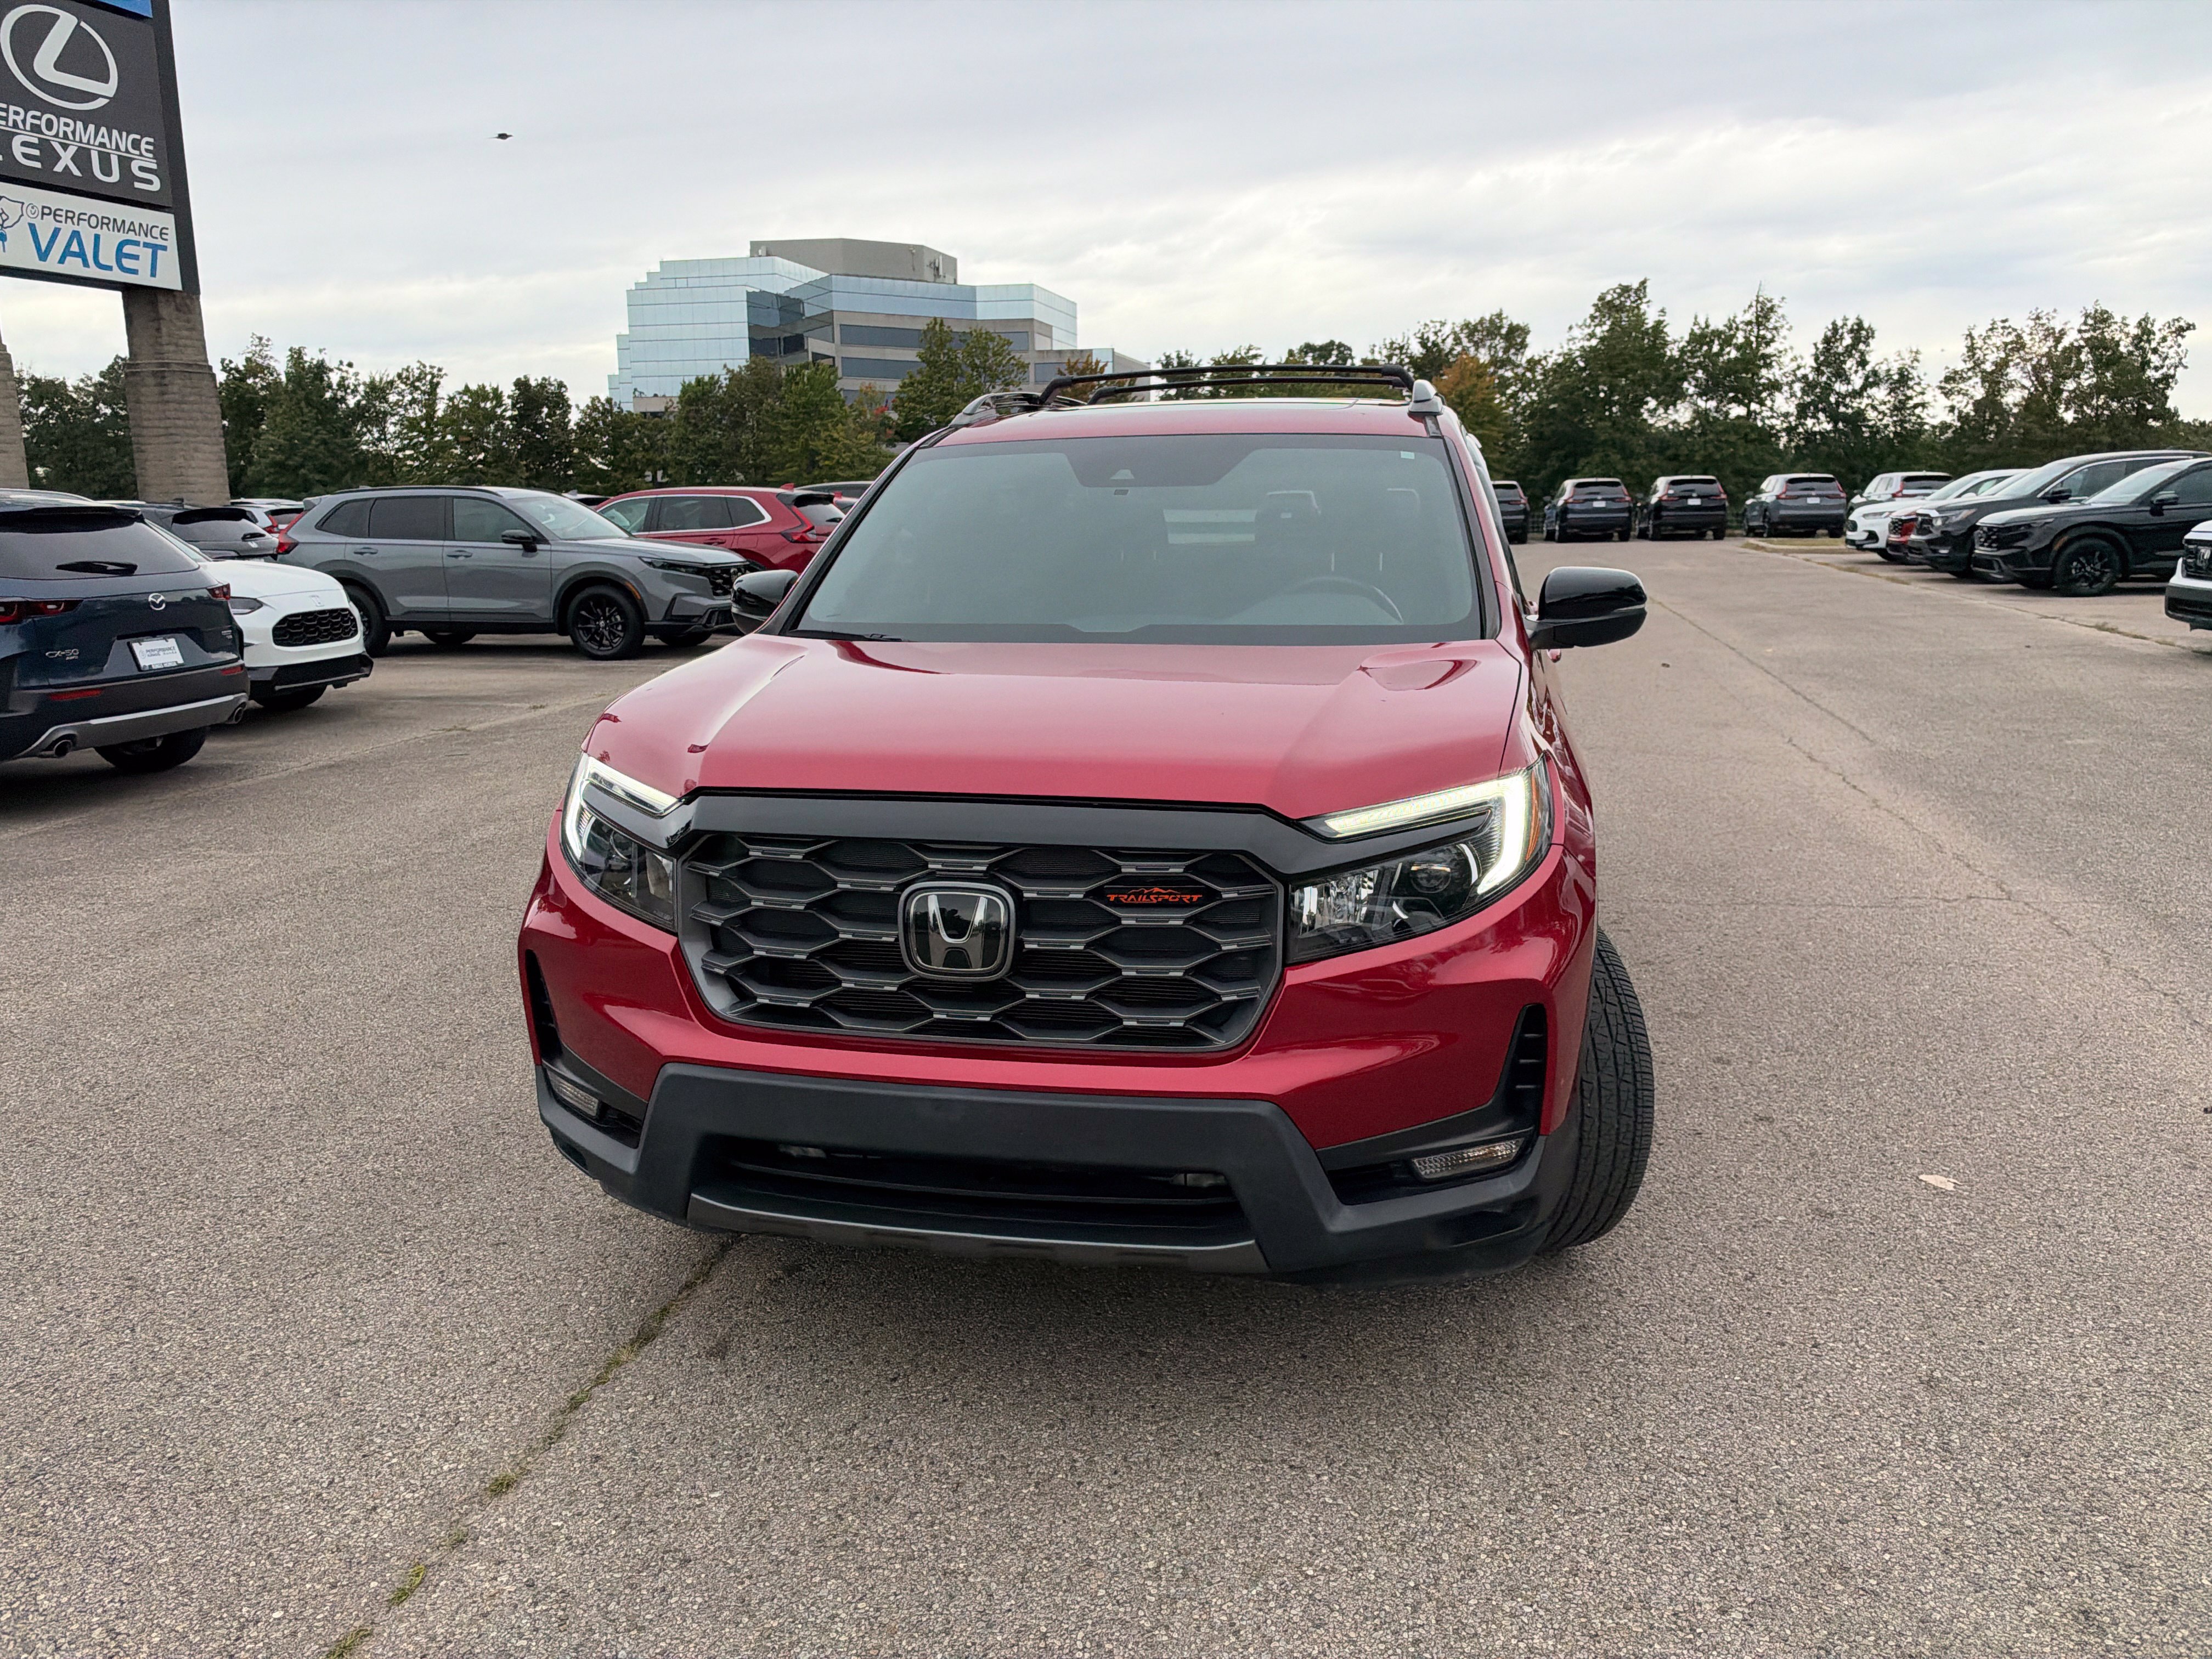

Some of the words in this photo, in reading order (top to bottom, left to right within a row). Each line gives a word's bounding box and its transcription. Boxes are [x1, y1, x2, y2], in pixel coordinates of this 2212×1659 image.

[0, 134, 161, 191] EXUS
[41, 205, 169, 241] PERFORMANCE
[27, 222, 168, 278] VALET
[46, 648, 80, 658] CX-50
[1107, 894, 1203, 904] TRAILSPORT
